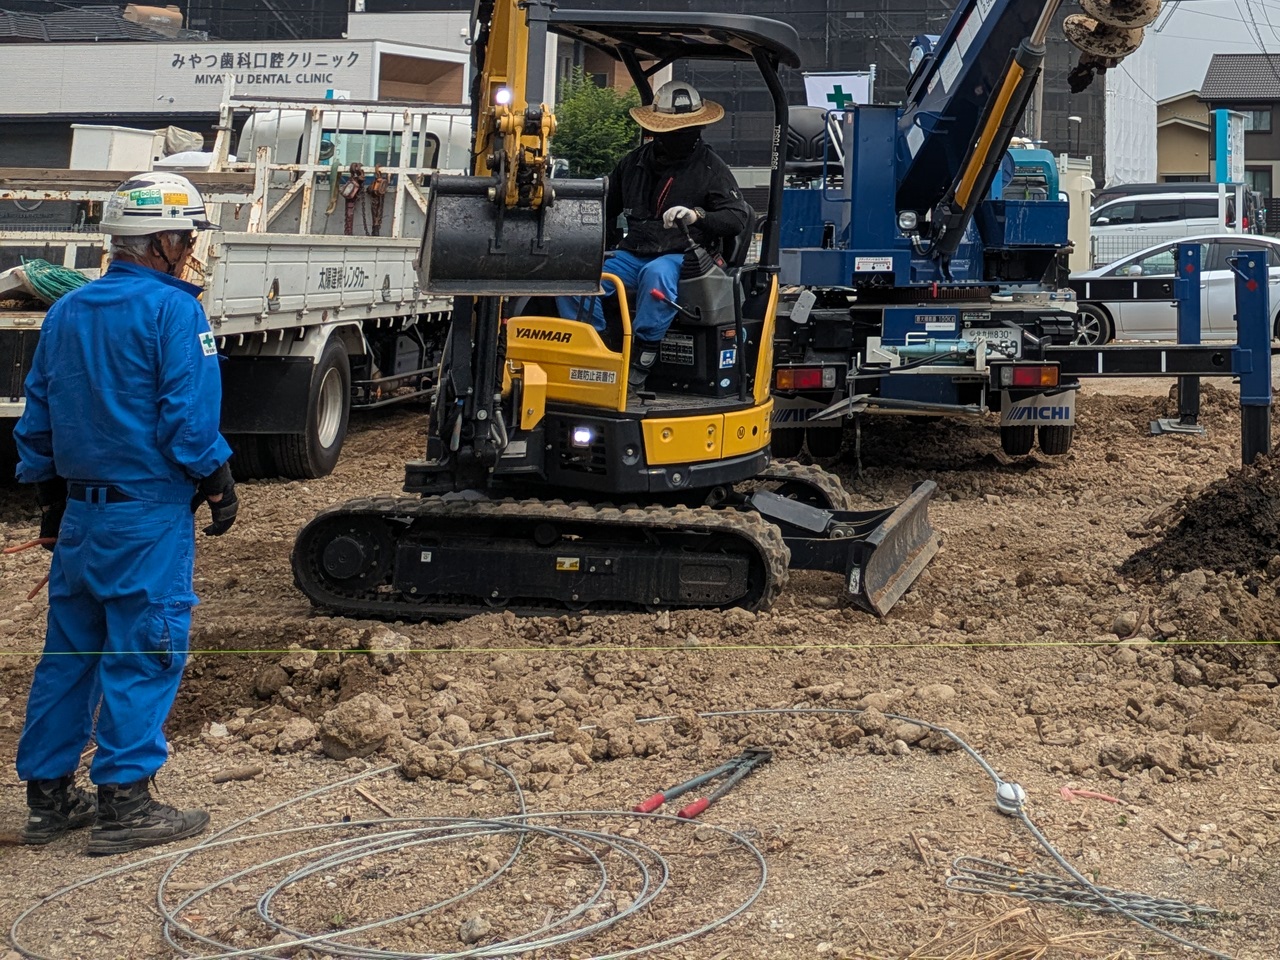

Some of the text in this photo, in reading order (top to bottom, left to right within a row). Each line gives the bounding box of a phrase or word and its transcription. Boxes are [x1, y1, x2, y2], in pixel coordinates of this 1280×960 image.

[171, 52, 360, 70] みやつ歯科口腔クリニック
[194, 73, 333, 84] MIYAU DENTAL CLINIC
[515, 327, 573, 343] YANMAR
[1006, 406, 1070, 420] AICHI
